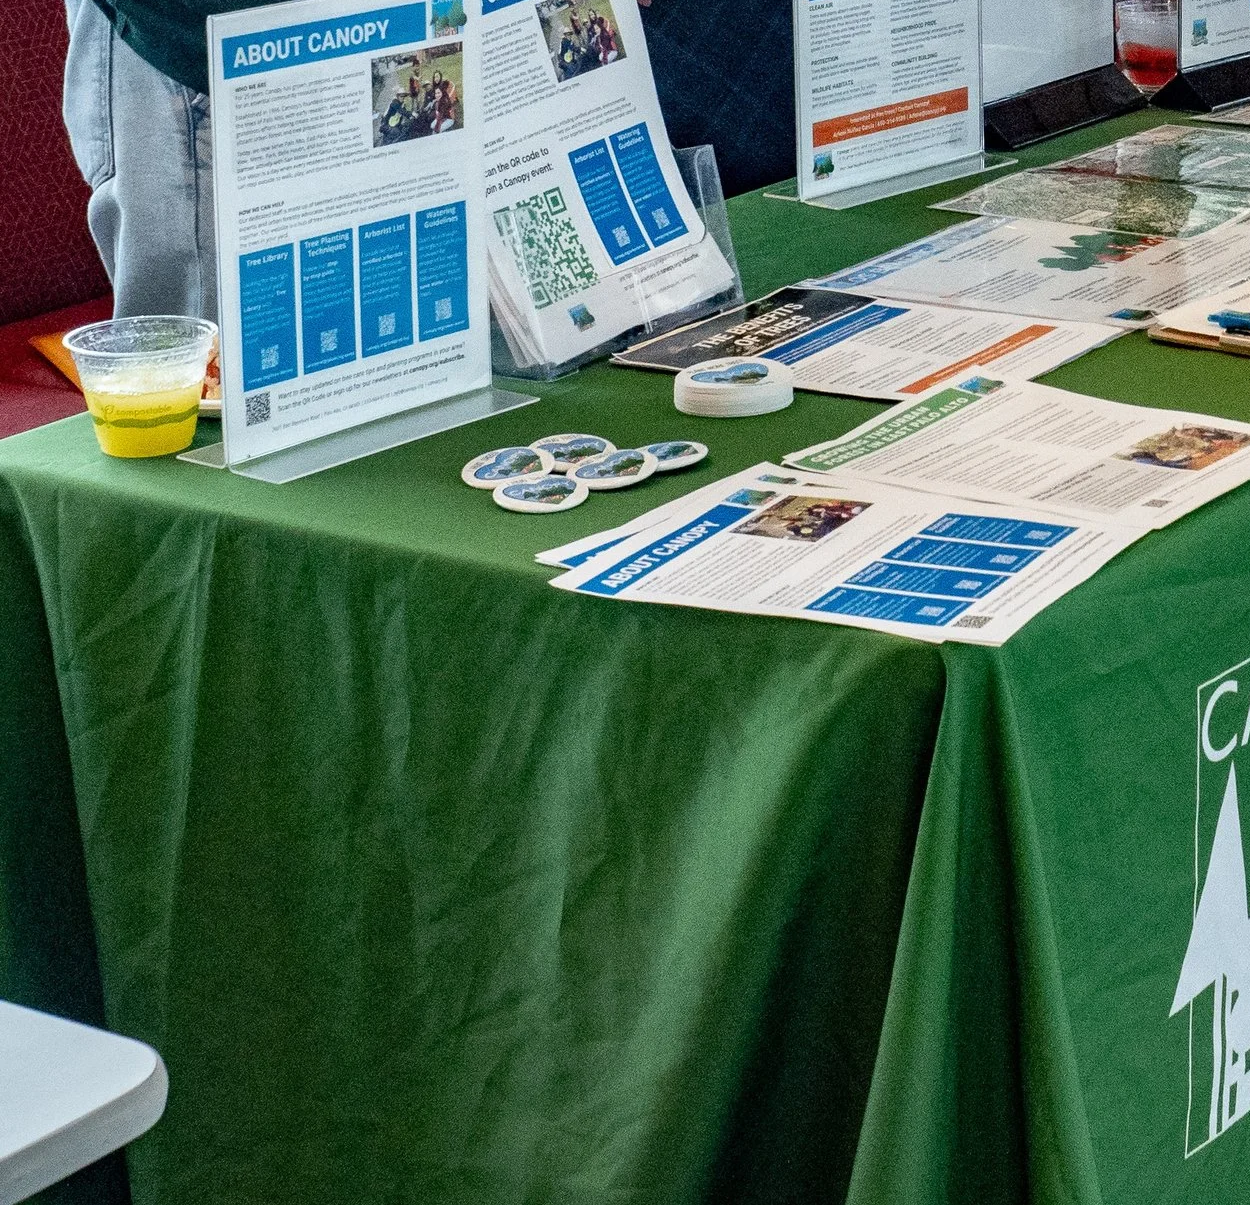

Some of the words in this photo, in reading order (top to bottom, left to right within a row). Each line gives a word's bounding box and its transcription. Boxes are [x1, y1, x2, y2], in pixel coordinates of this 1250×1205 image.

[233, 35, 304, 68] ABOUT
[308, 19, 390, 53] CANOPY
[497, 163, 510, 172] the
[510, 157, 521, 167] QR
[522, 151, 540, 163] code
[540, 147, 549, 156] to
[504, 172, 530, 187] Canopy
[531, 163, 554, 177] event:
[423, 213, 458, 229] Guidelines
[426, 205, 456, 221] Watering
[304, 238, 319, 251] Tree
[320, 230, 349, 247] Planting
[364, 225, 391, 239] Arborist
[392, 222, 405, 232] List
[246, 256, 261, 267] Tree
[262, 249, 288, 265] Library
[307, 240, 346, 258] Techniques
[692, 333, 734, 348] THE
[726, 303, 804, 335] BENEFITS
[734, 335, 761, 347] OF
[757, 315, 811, 337] TREES
[810, 439, 869, 463] GROWING
[868, 426, 893, 441] THE
[892, 406, 930, 428] URBAN
[823, 444, 871, 466] FOREST
[872, 439, 885, 447] IN
[883, 426, 911, 442] EAST
[910, 412, 941, 428] PALO
[939, 397, 968, 413] ALTO
[601, 555, 660, 588] ABOUT
[652, 520, 720, 556] CANOPY
